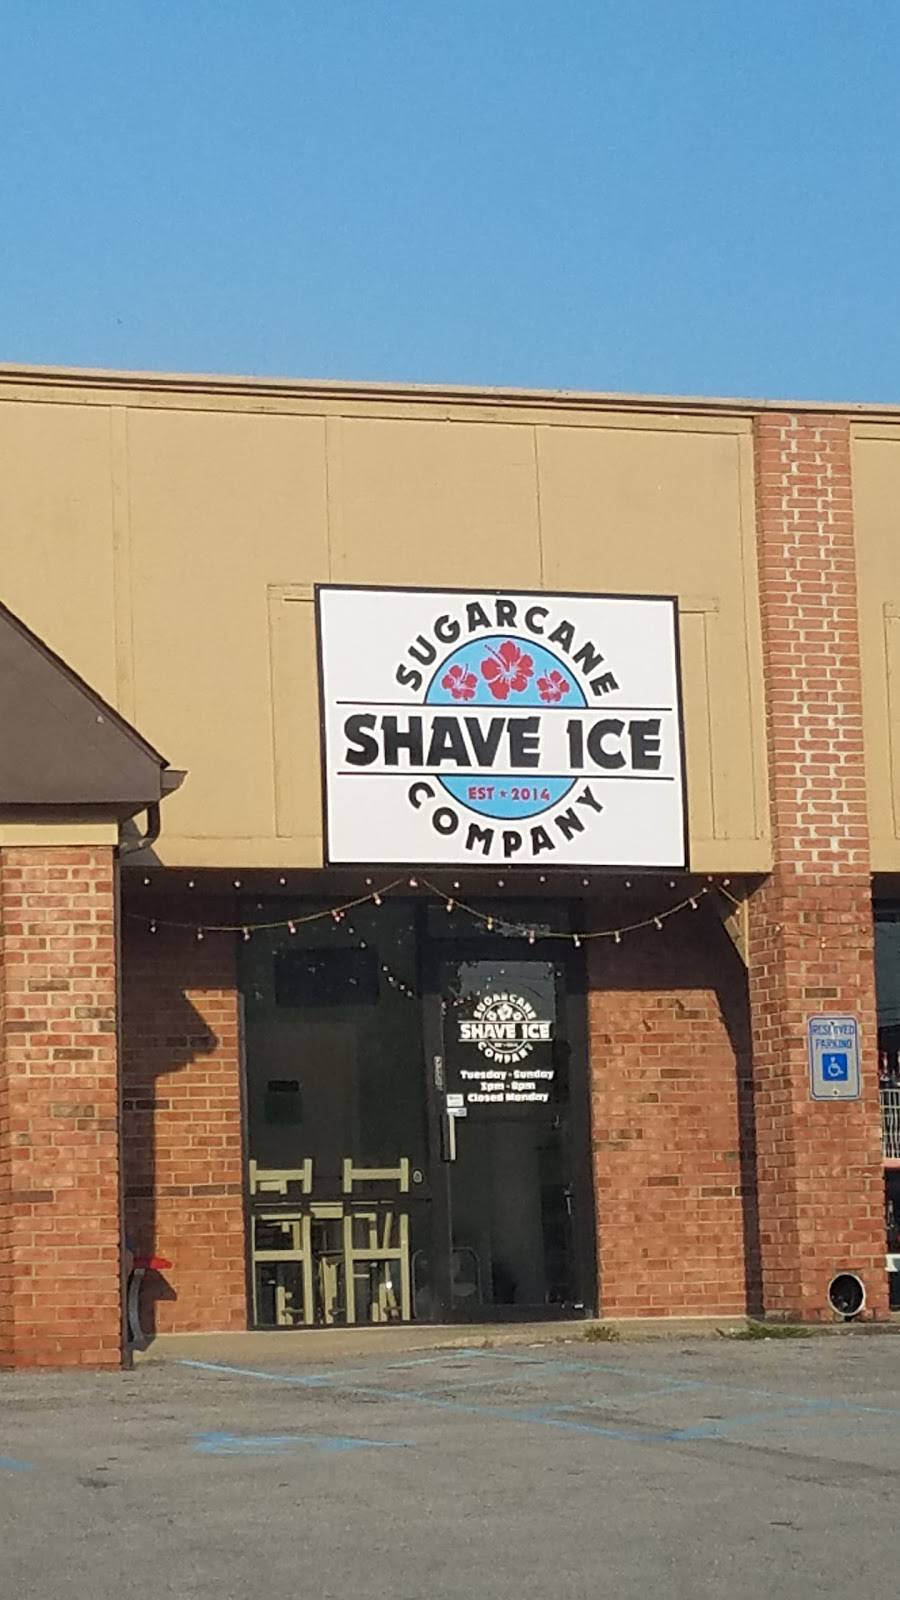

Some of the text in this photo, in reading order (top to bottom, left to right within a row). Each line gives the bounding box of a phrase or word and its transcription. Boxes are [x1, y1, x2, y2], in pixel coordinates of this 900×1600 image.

[396, 599, 619, 697] SUGARCANE
[344, 713, 662, 770] SHAVE ICE
[468, 786, 550, 801] EST 2014
[408, 781, 603, 858] COMPANY
[460, 1023, 550, 1039] SHAVE ICE
[816, 1038, 852, 1049] PARKING
[477, 1041, 534, 1064] COMPANY
[460, 1070, 507, 1080] Tuesday
[513, 1070, 555, 1080] Sunday
[467, 1093, 504, 1103] Closed
[505, 1092, 549, 1103] Monday
